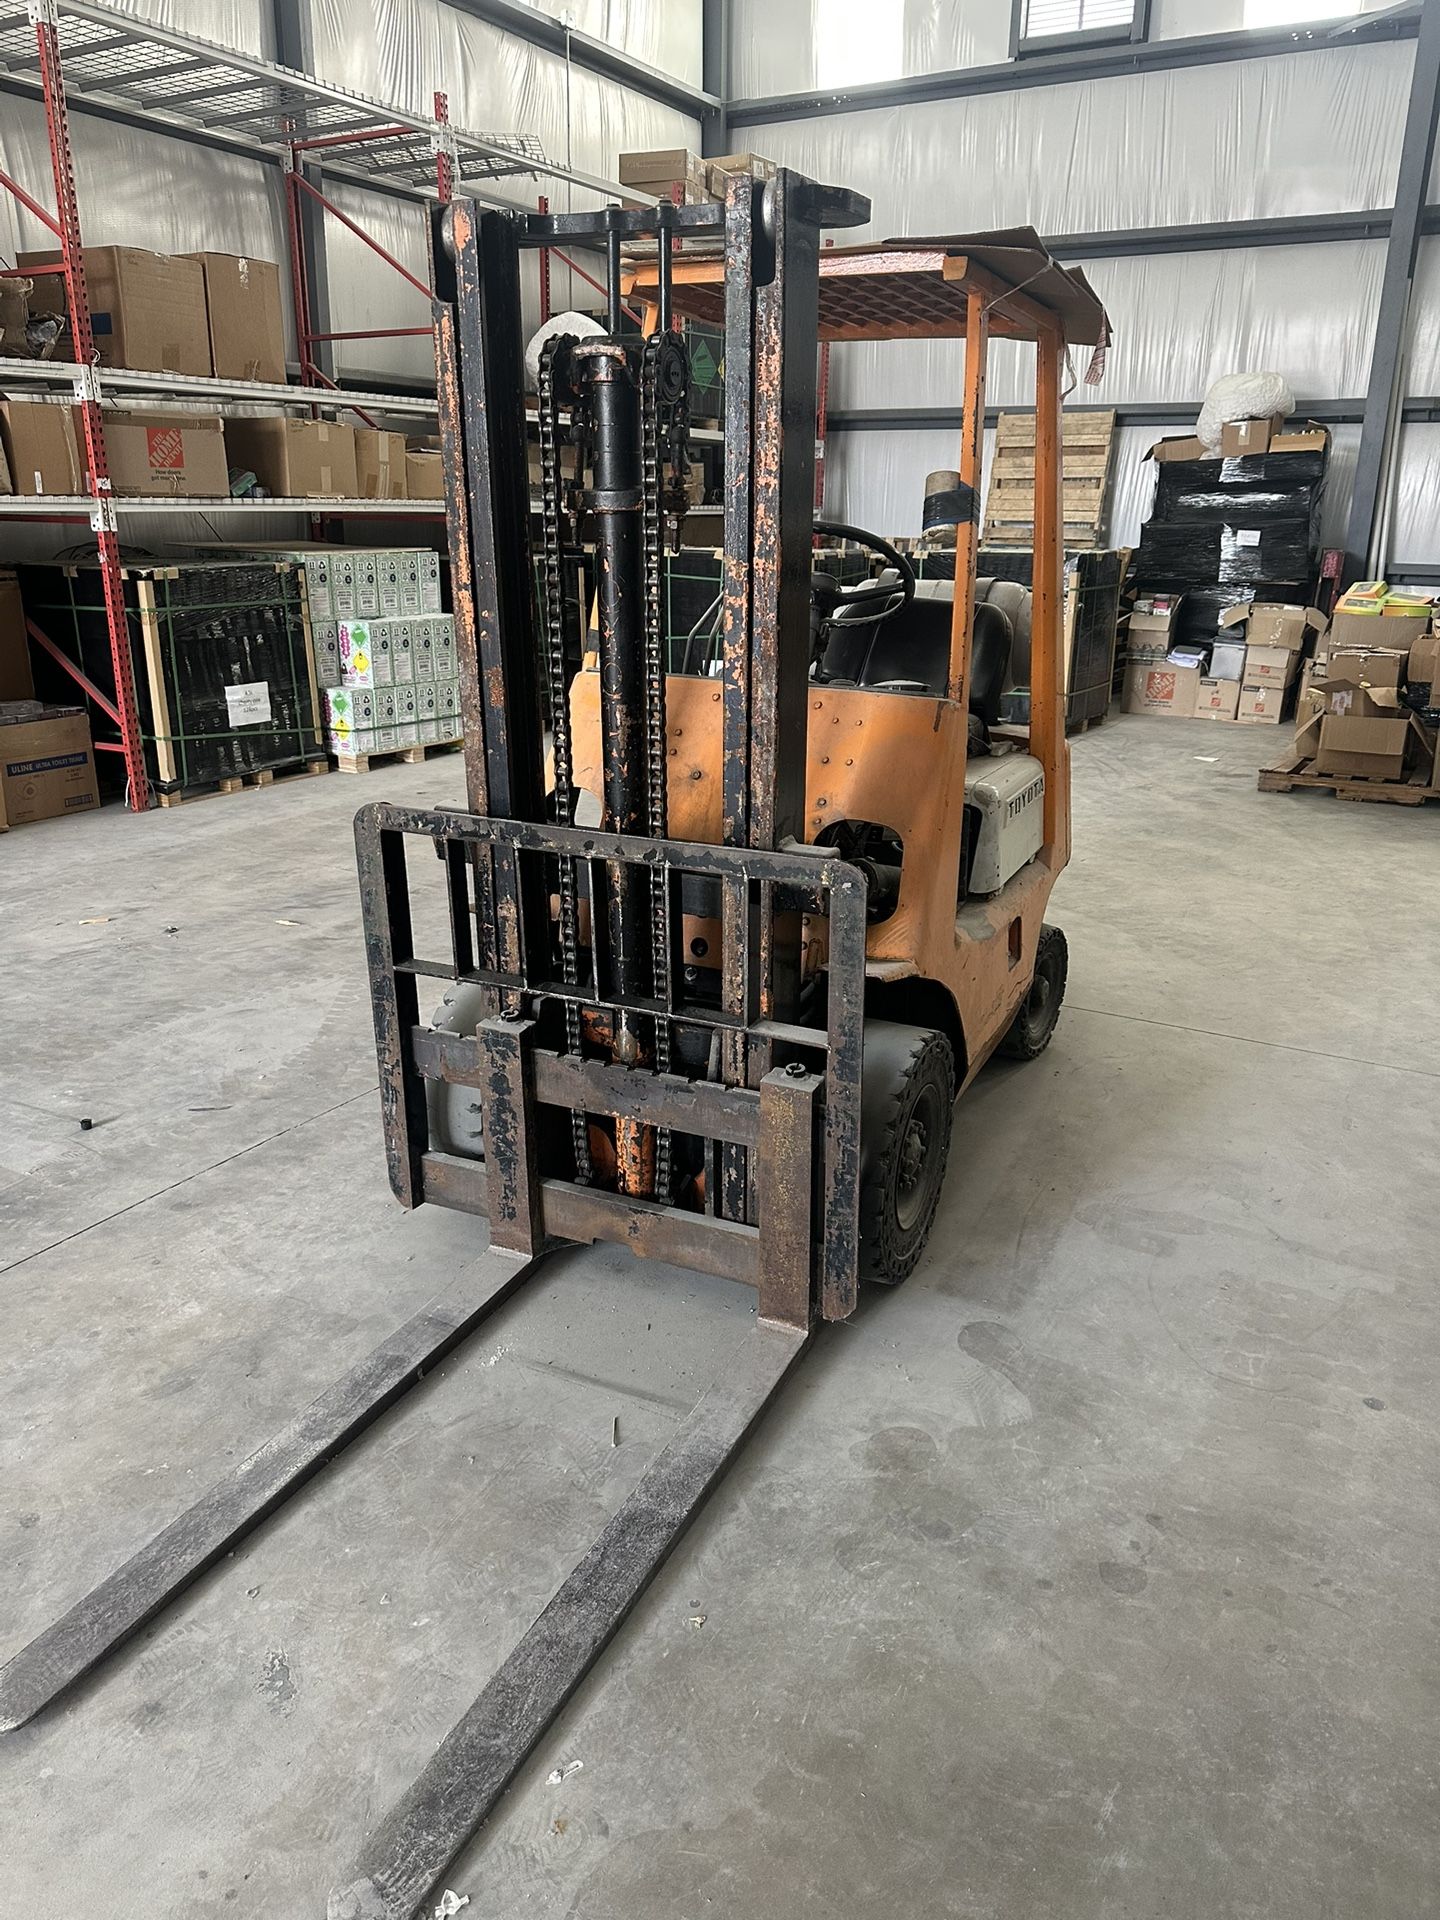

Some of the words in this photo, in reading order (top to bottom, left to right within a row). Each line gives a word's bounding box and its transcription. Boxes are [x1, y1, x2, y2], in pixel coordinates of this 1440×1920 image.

[149, 428, 182, 466] HOME
[11, 763, 33, 774] ULINE
[1009, 778, 1043, 818] TOYOTA
